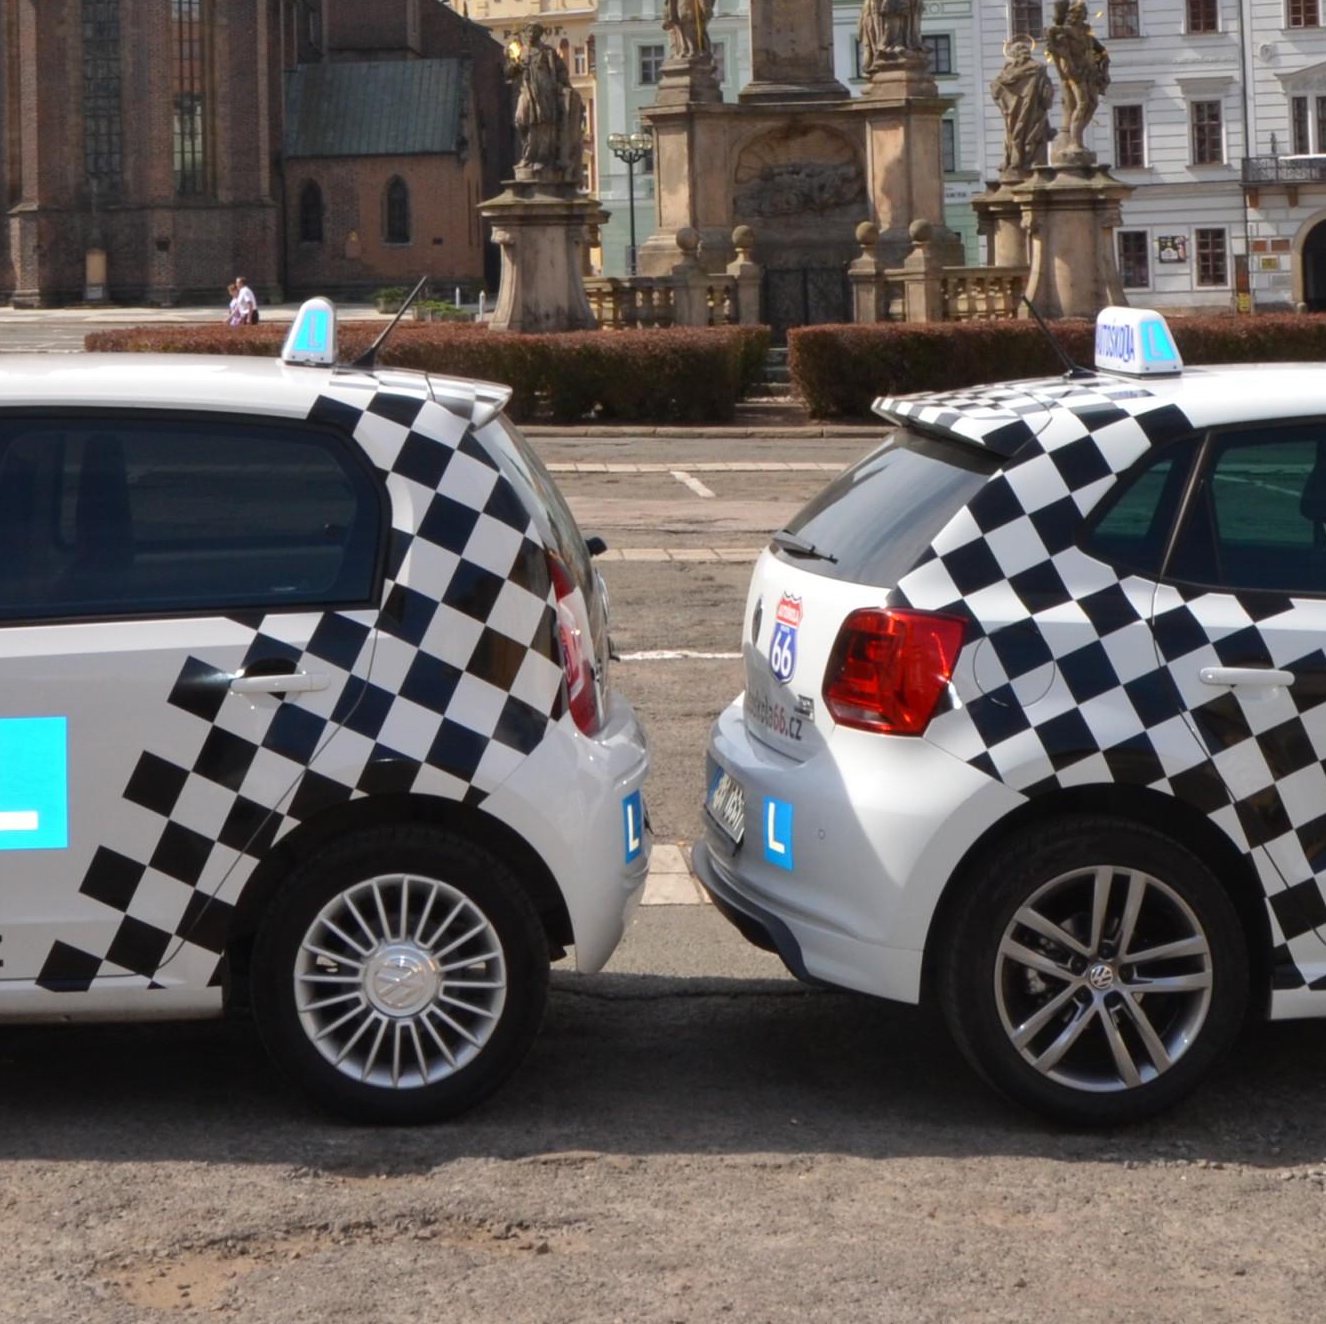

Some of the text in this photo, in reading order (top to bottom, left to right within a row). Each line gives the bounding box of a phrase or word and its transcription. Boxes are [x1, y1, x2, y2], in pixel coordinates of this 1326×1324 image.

[771, 631, 792, 677] 66
[627, 804, 640, 852] L
[768, 801, 785, 854] L
